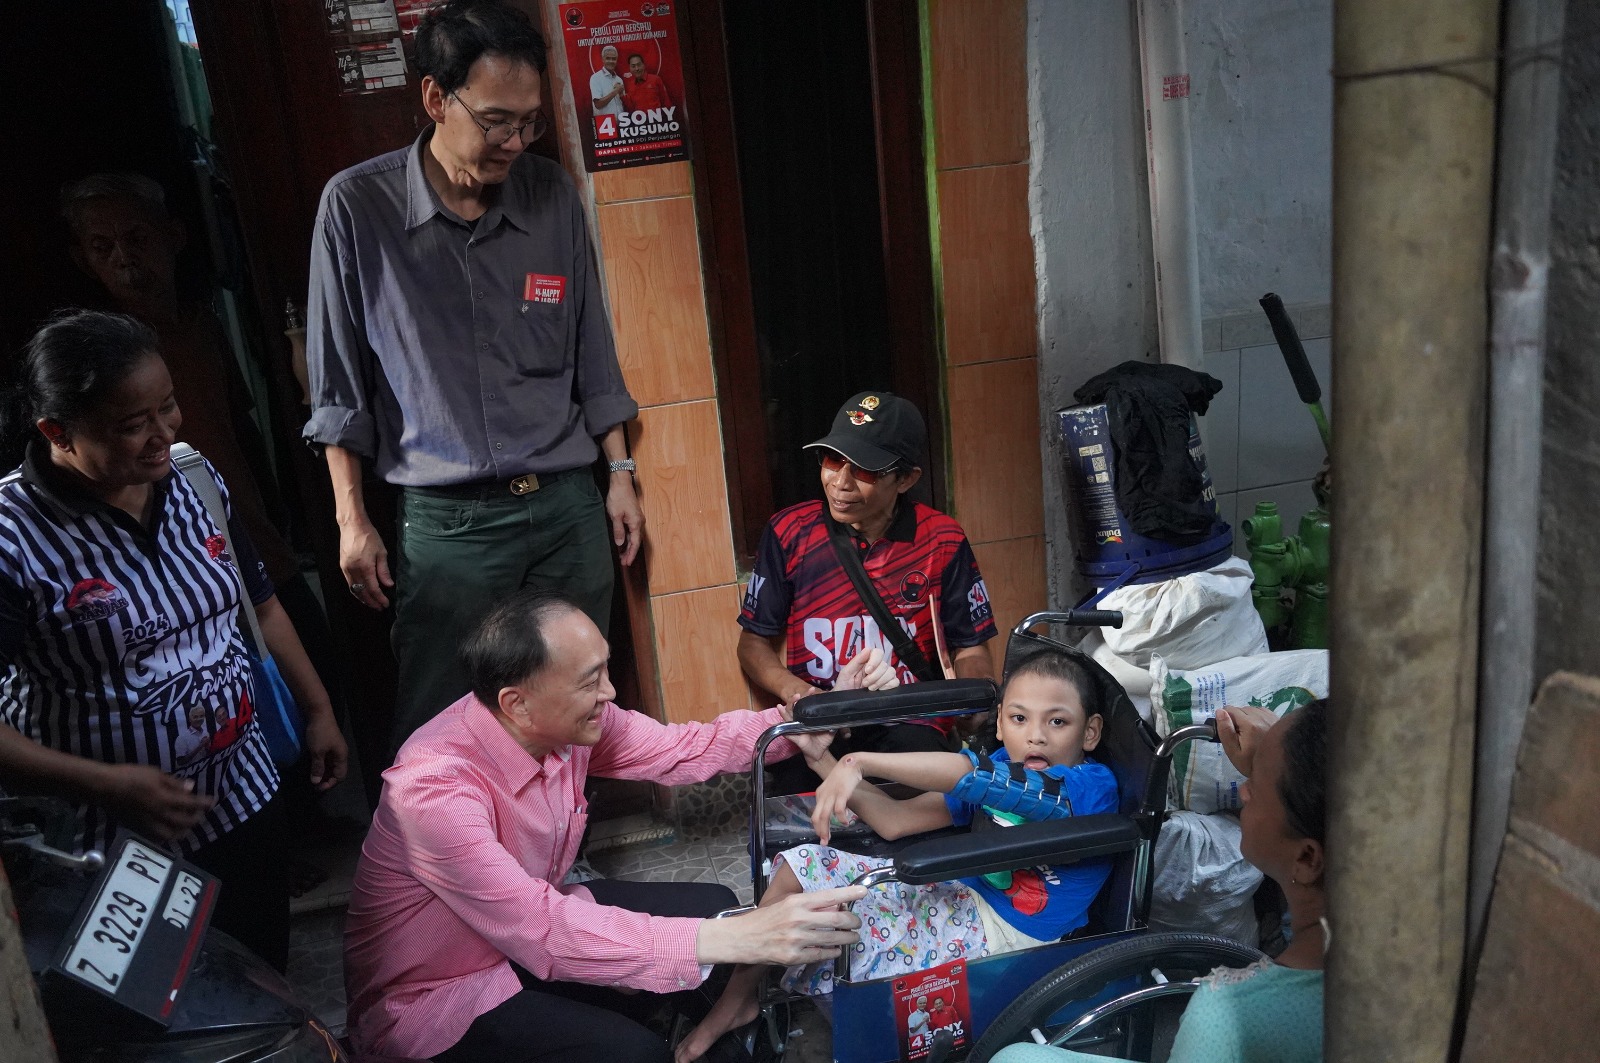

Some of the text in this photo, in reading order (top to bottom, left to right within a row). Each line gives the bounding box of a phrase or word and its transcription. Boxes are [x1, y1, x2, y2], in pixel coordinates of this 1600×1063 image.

[599, 117, 616, 137] 4
[618, 106, 676, 128] SONY
[620, 121, 680, 138] KUSUMO
[541, 288, 561, 298] HAPPY
[122, 615, 169, 645] 2024
[77, 847, 167, 987] Z 3229 PY
[911, 1035, 923, 1048] 4
